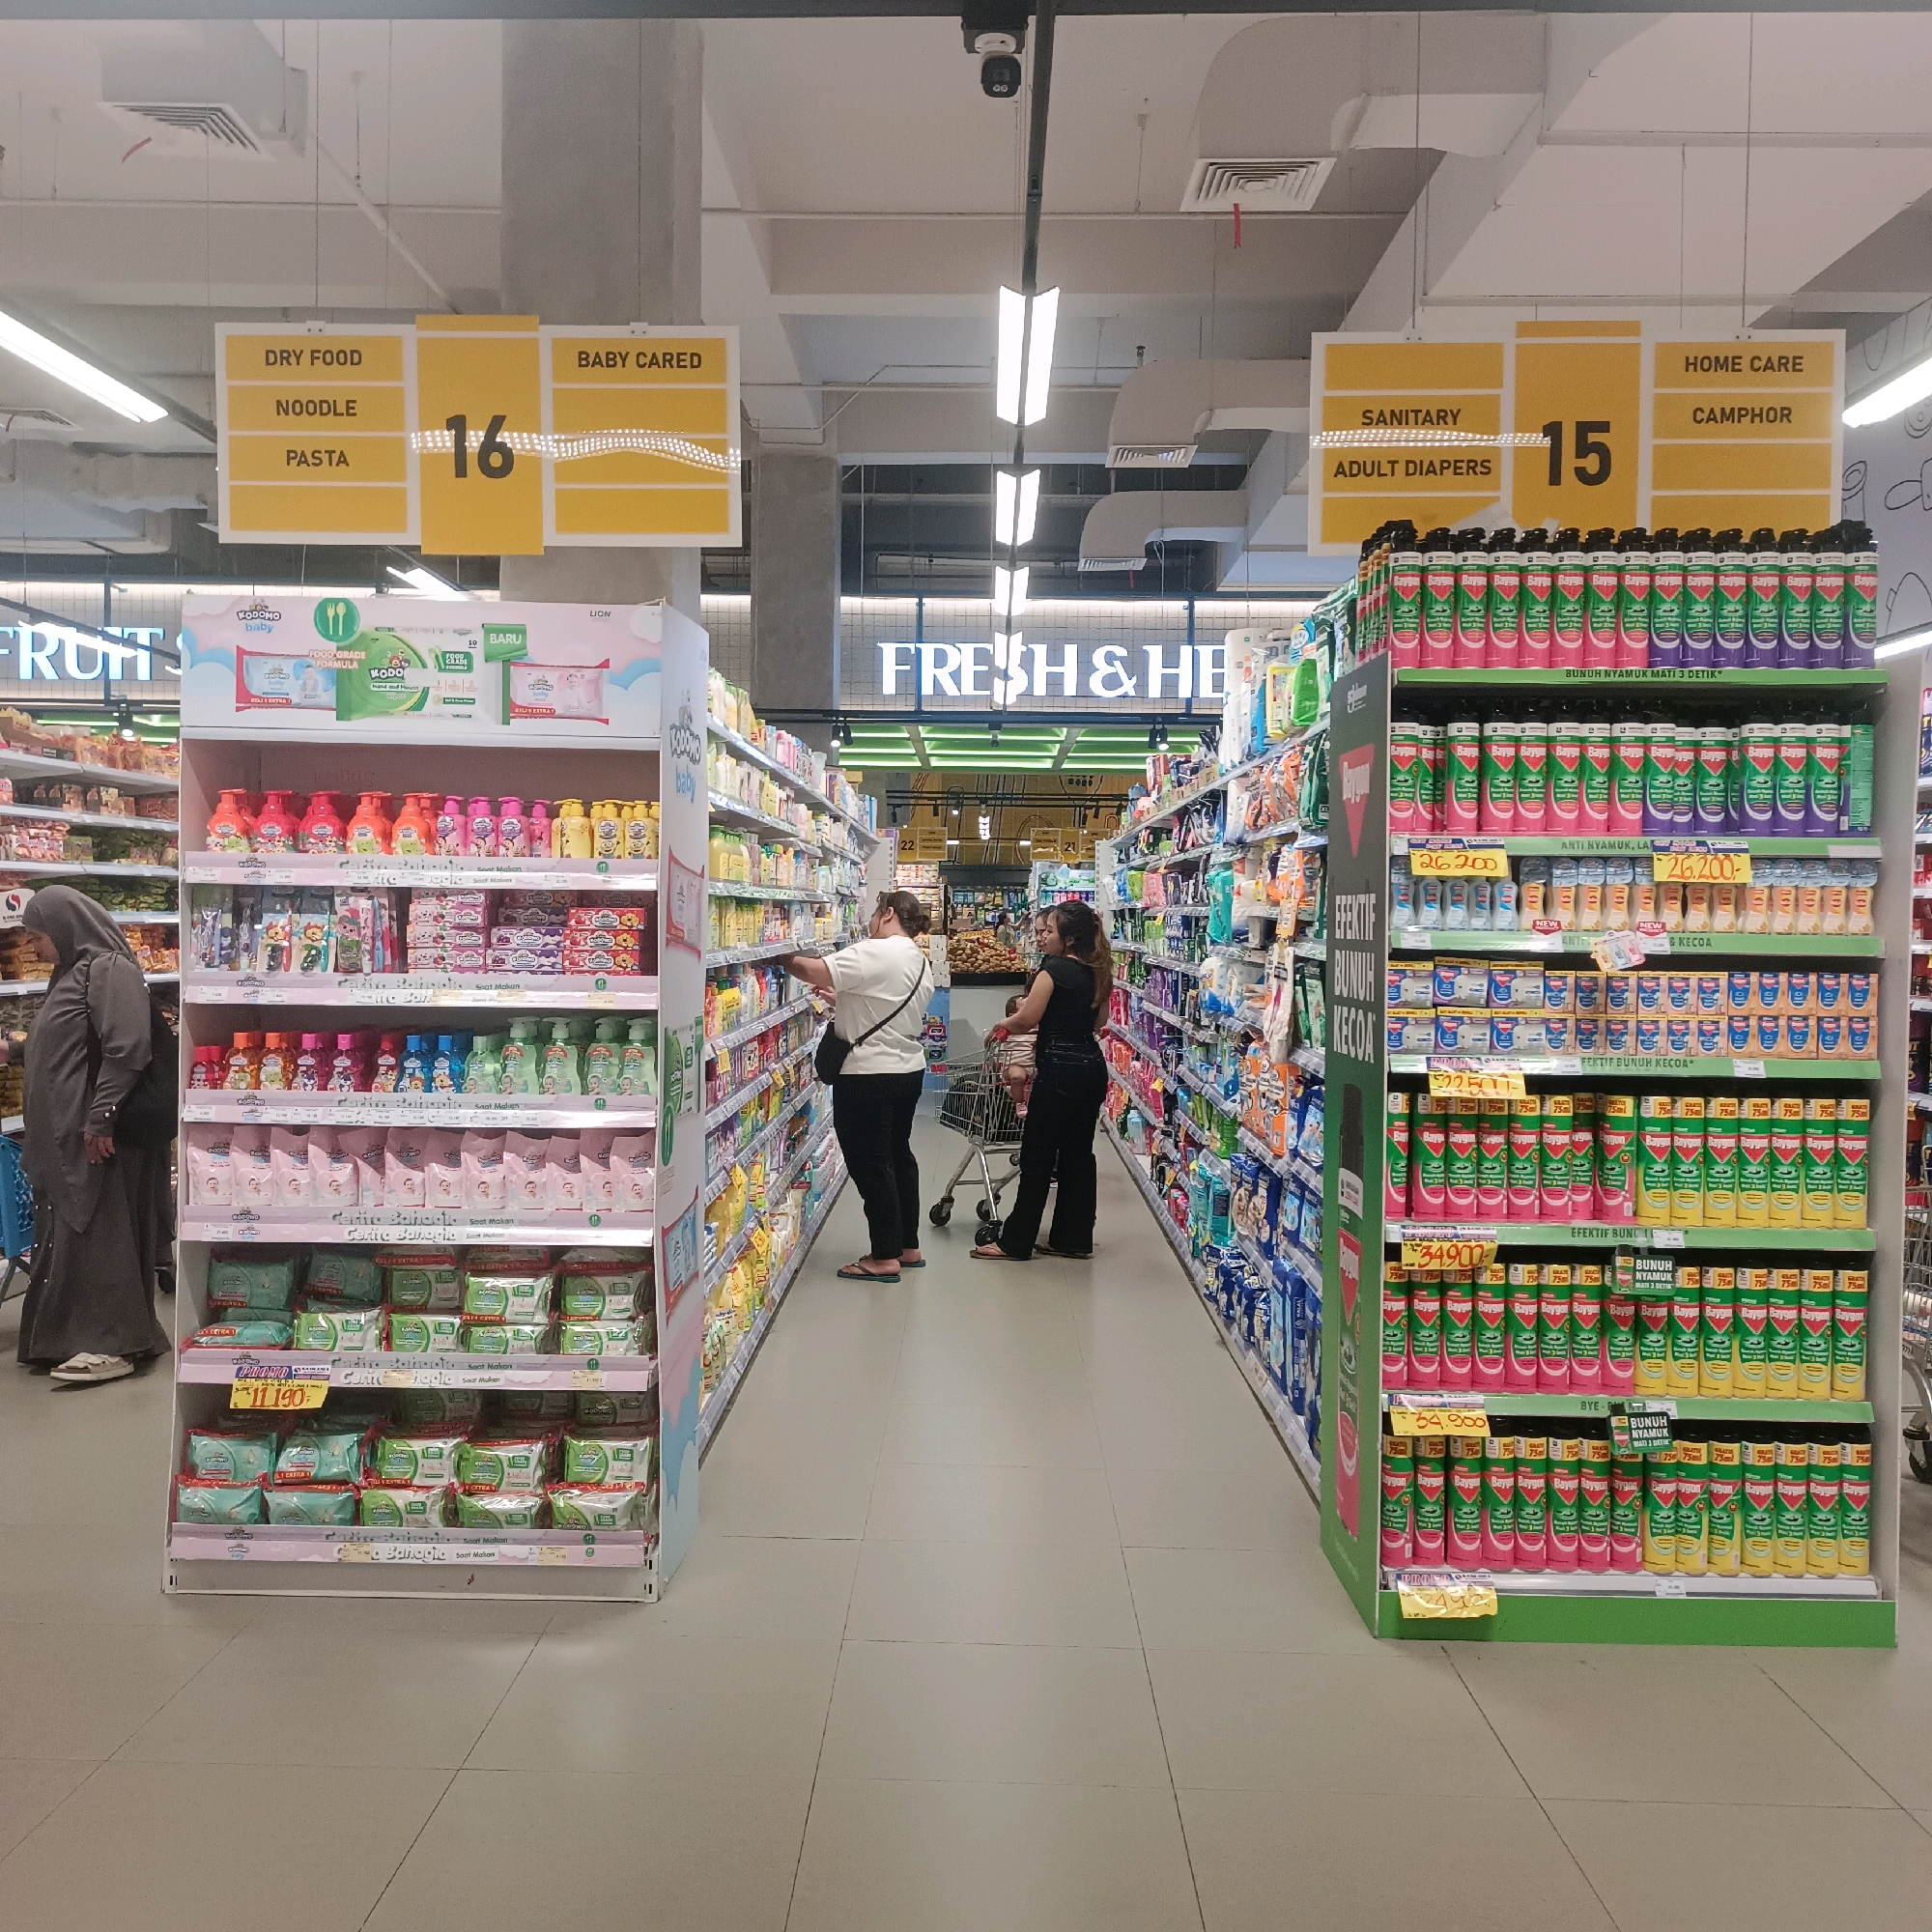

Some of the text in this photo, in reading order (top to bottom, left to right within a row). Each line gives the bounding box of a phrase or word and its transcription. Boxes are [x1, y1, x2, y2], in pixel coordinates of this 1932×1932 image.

[265, 349, 362, 367] DRY FOOD
[578, 351, 702, 370] BABY CARED
[1684, 355, 1804, 374] HOME CARE
[275, 399, 357, 417] NOODLE
[1361, 408, 1462, 427] SANITARY
[1692, 407, 1793, 425] CAMPHOR
[445, 413, 515, 480] 16
[285, 449, 350, 469] PASTA
[1542, 420, 1612, 487] 15
[1333, 459, 1492, 479] ADULT DIAPERS
[237, 610, 282, 621] KODOMO
[589, 610, 611, 618] LION
[245, 622, 274, 634] baby
[489, 633, 523, 644] BARU
[309, 649, 365, 660] FOOD GRADE
[316, 660, 358, 669] FORMULA
[876, 641, 1078, 697] FRESH
[1089, 644, 1137, 698] &
[369, 667, 405, 680] KODO
[1566, 669, 1602, 678] BUNUH
[1605, 669, 1648, 678] NYAMUK
[1651, 669, 1676, 678] MATI
[1679, 669, 1685, 678] 3
[669, 722, 701, 764] KODOMO
[675, 765, 696, 804] baby
[900, 839, 915, 851] 22
[1064, 841, 1076, 852] 21
[1561, 841, 1584, 850] ANTI
[1335, 893, 1377, 941] EFEKTIF
[1679, 937, 1713, 948] KECOA
[1334, 949, 1376, 1003] BUNUH
[1581, 1057, 1614, 1067] FEKTIF
[1616, 1058, 1653, 1067] BUNUH
[1571, 1227, 1610, 1238] EFEKTIF
[1635, 1259, 1673, 1270] BUNUH
[1635, 1270, 1673, 1281] NYAMUK
[240, 1366, 289, 1378] PROMO
[1580, 1401, 1600, 1410] BYE
[1630, 1415, 1668, 1429] BUNUH
[1632, 1428, 1669, 1438] NYAMUK
